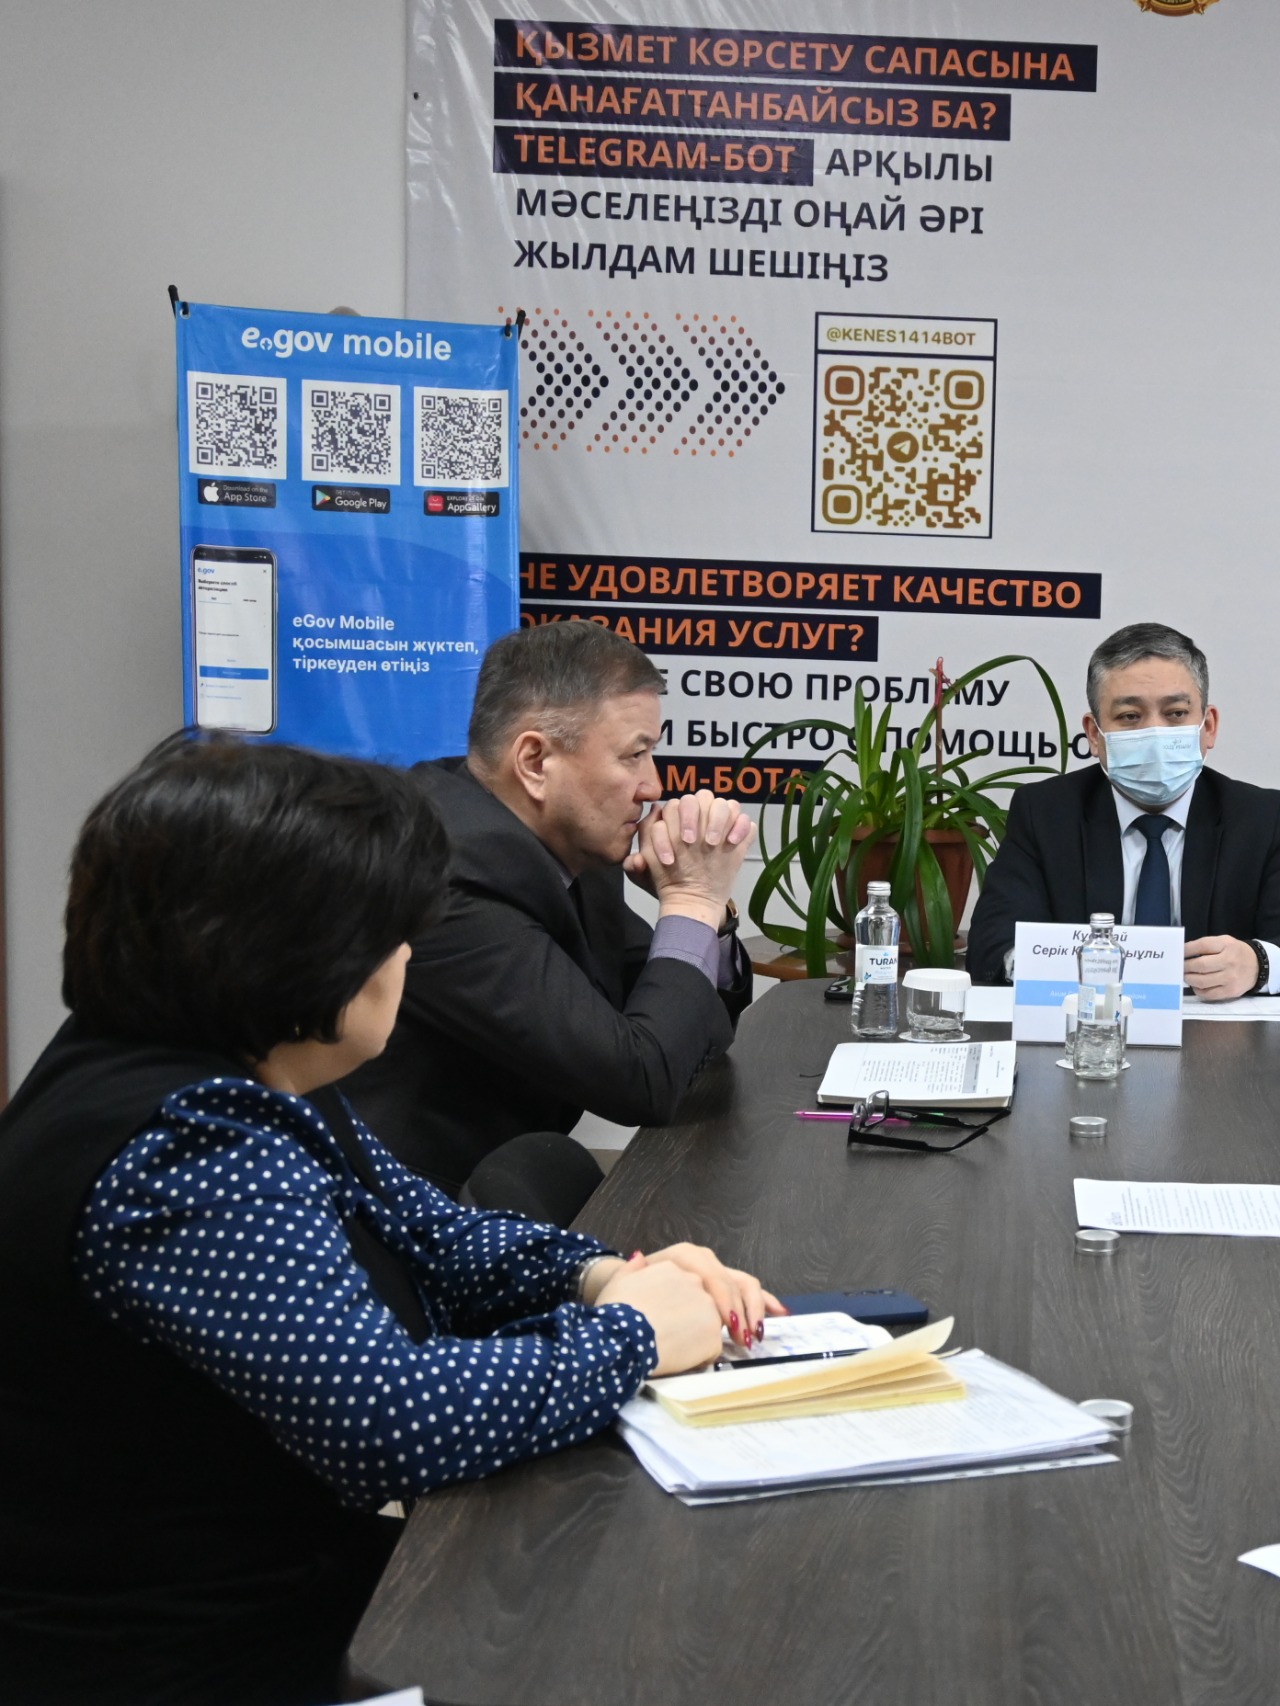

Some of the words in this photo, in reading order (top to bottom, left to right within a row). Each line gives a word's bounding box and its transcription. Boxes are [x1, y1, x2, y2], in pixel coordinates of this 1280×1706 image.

[515, 30, 677, 66] ҚЫЗМЕТ
[688, 42, 853, 74] КӨРСЕТУ
[864, 46, 1076, 82] САПАСЫНА
[515, 82, 918, 126] ҚАНАҒАТТАНБАЙСЫЗ
[931, 99, 997, 130] БА?
[514, 134, 795, 174] TELEGRAM-БОТ
[825, 149, 993, 184] АРҚЫЛЫ
[516, 187, 782, 232] МӘСЕЛЕҢІЗДІ
[793, 194, 906, 237] ОҢАЙ
[919, 203, 983, 235] ӘРІ
[513, 239, 695, 279] ЖЫЛДАМ
[709, 246, 888, 288] ШЕШІҢІЗ
[342, 330, 452, 361] mobile
[826, 327, 976, 346] @KENES1414BOT
[224, 492, 243, 503] App
[244, 493, 267, 503] Store
[335, 496, 367, 509] Google
[368, 498, 387, 510] Play
[448, 503, 497, 513] AppGallery
[568, 564, 882, 603] УДОВЛЕТВОРЯЕТ
[893, 575, 1083, 610] КАЧЕСТВО
[293, 614, 336, 631] eGov
[340, 614, 395, 632] Mobile
[728, 618, 866, 653] УСЛУГ?
[293, 637, 408, 655] қосымшасын
[413, 639, 480, 657] жүктеп,
[293, 656, 377, 674] тіркеуден
[381, 658, 430, 676] өтіңіз
[681, 669, 793, 700] СВОЮ
[806, 674, 1010, 707] ПРОБЛМУ
[688, 721, 835, 752] БЫСТРО
[1032, 944, 1068, 958] Серік
